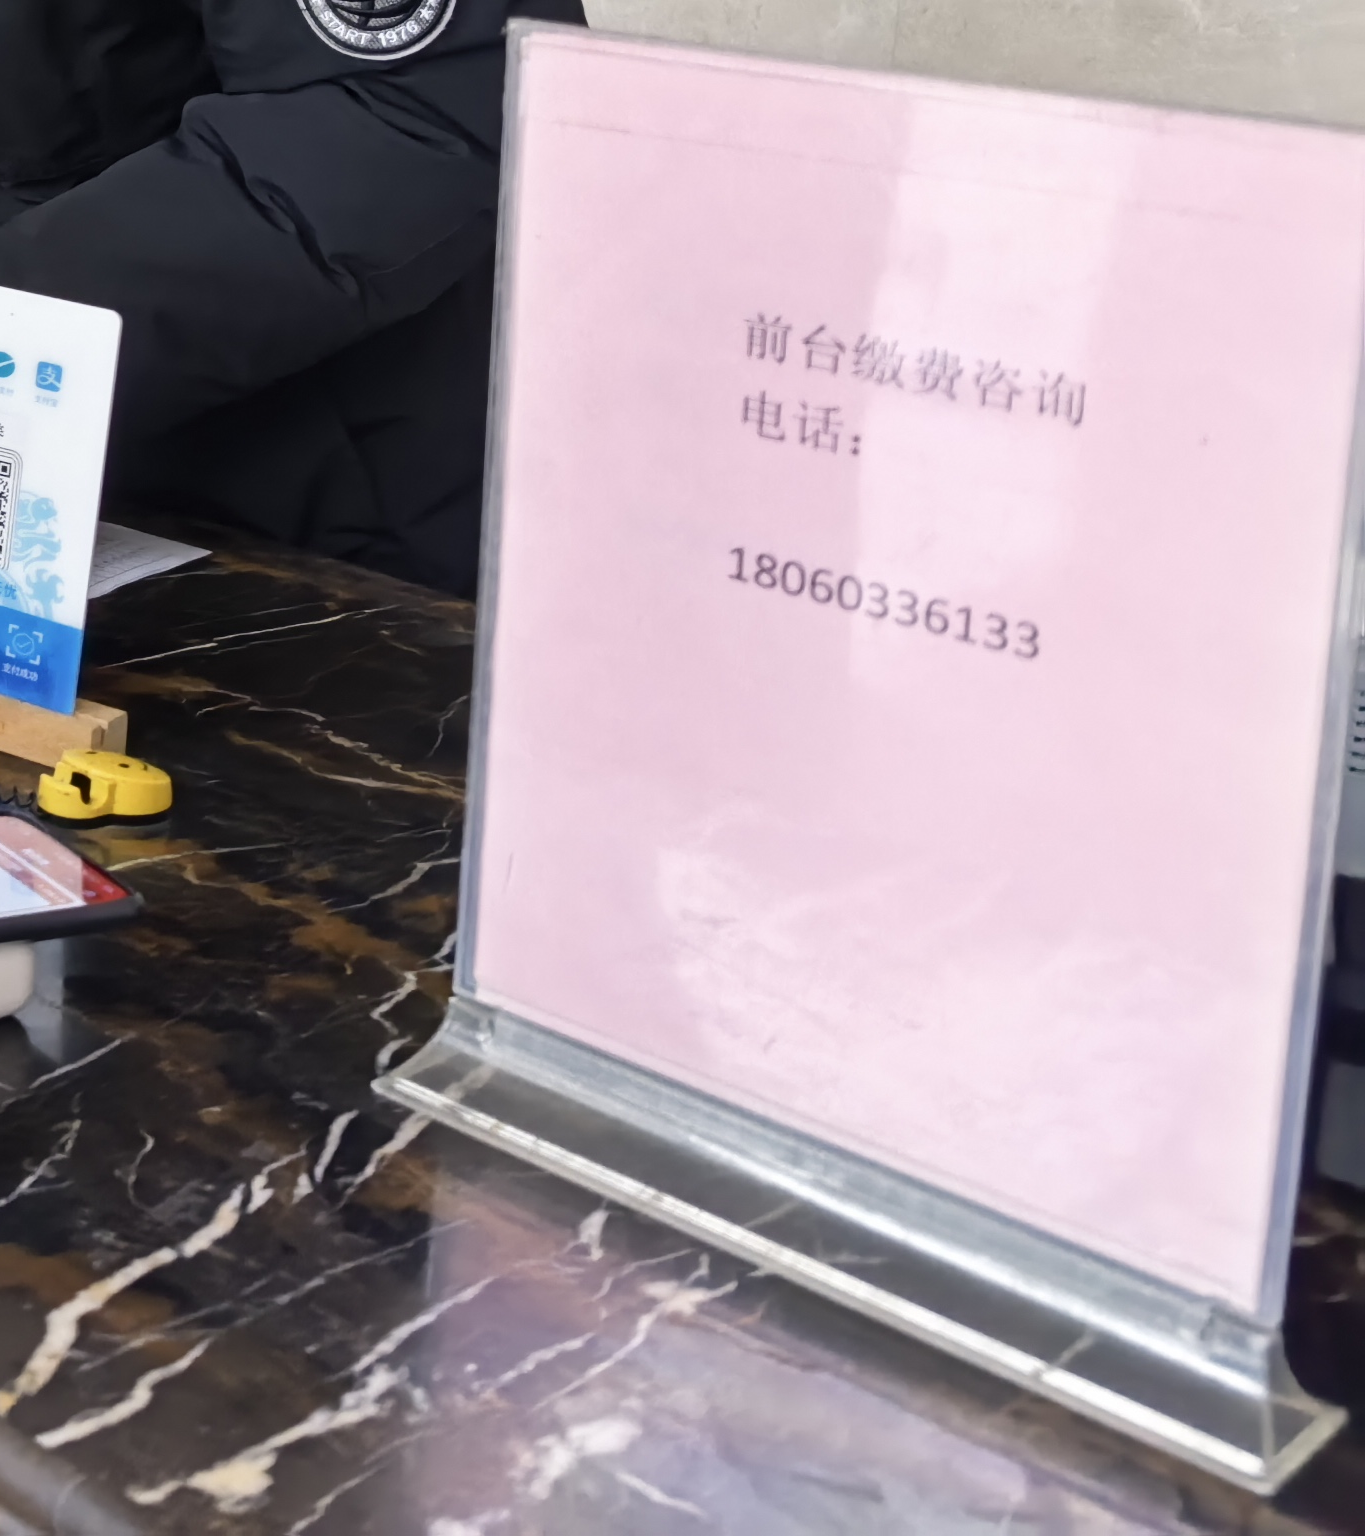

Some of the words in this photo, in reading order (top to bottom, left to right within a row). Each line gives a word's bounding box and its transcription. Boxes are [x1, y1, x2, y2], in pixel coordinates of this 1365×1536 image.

[320, 10, 372, 45] START
[377, 20, 420, 47] 1976
[741, 309, 1088, 428] 前台缴费咨询
[725, 543, 1042, 662] 18060336133
[1, 661, 38, 682] 支付成功
